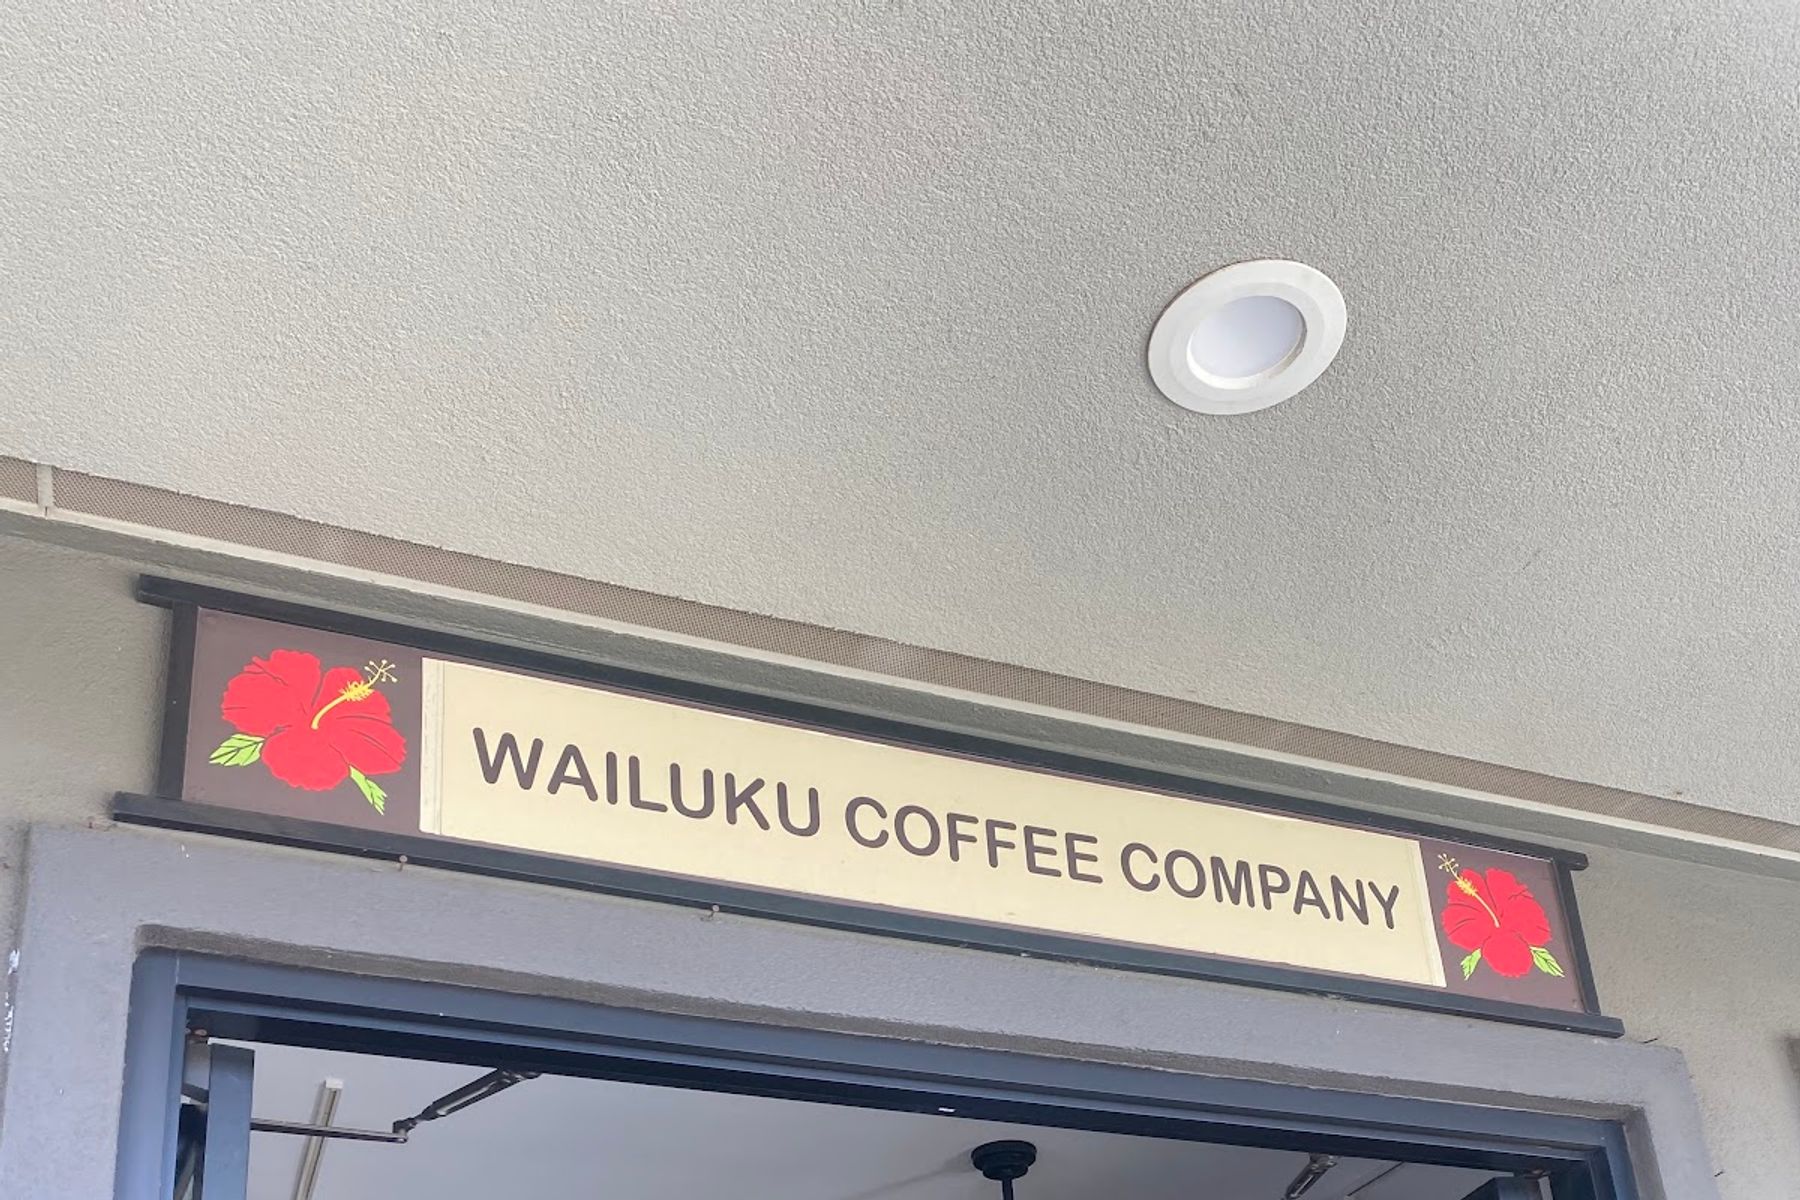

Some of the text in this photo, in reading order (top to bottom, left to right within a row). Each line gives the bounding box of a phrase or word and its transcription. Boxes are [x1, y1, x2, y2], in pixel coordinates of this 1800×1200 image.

[473, 727, 1399, 930] WAILUKU COFFEE COMPANY
